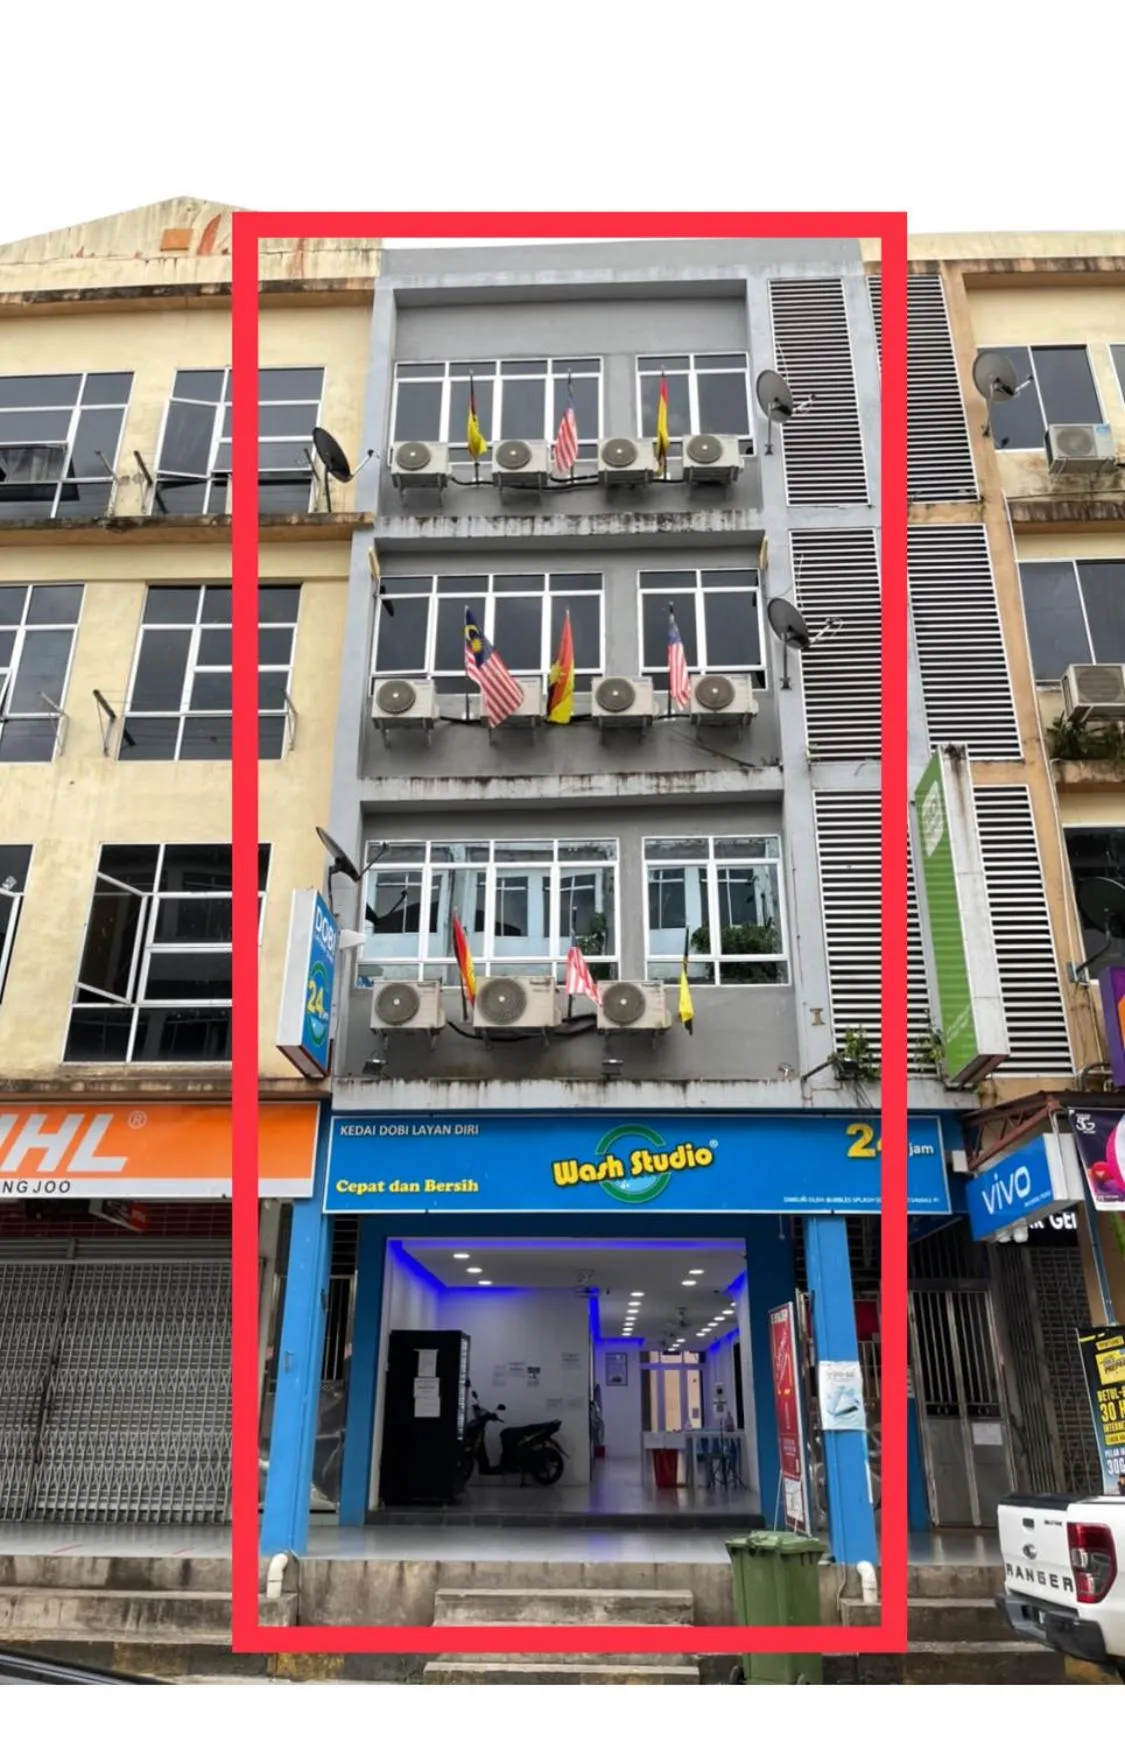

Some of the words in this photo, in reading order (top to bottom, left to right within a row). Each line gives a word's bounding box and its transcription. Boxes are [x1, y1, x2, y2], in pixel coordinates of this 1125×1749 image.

[307, 979, 324, 1015] 24
[340, 1124, 376, 1136] KEDAI
[380, 1124, 409, 1136] DOBI
[412, 1123, 452, 1135] LAYAN
[455, 1123, 479, 1135] DIRI
[846, 1122, 882, 1158] 2
[908, 1141, 934, 1157] jam
[551, 1154, 625, 1187] Wash
[629, 1142, 714, 1176] Studio
[336, 1179, 385, 1196] Cepat
[389, 1179, 420, 1193] dan
[424, 1178, 479, 1193] Bersih
[981, 1166, 1031, 1211] vivo
[1006, 1563, 1074, 1592] RANGER
